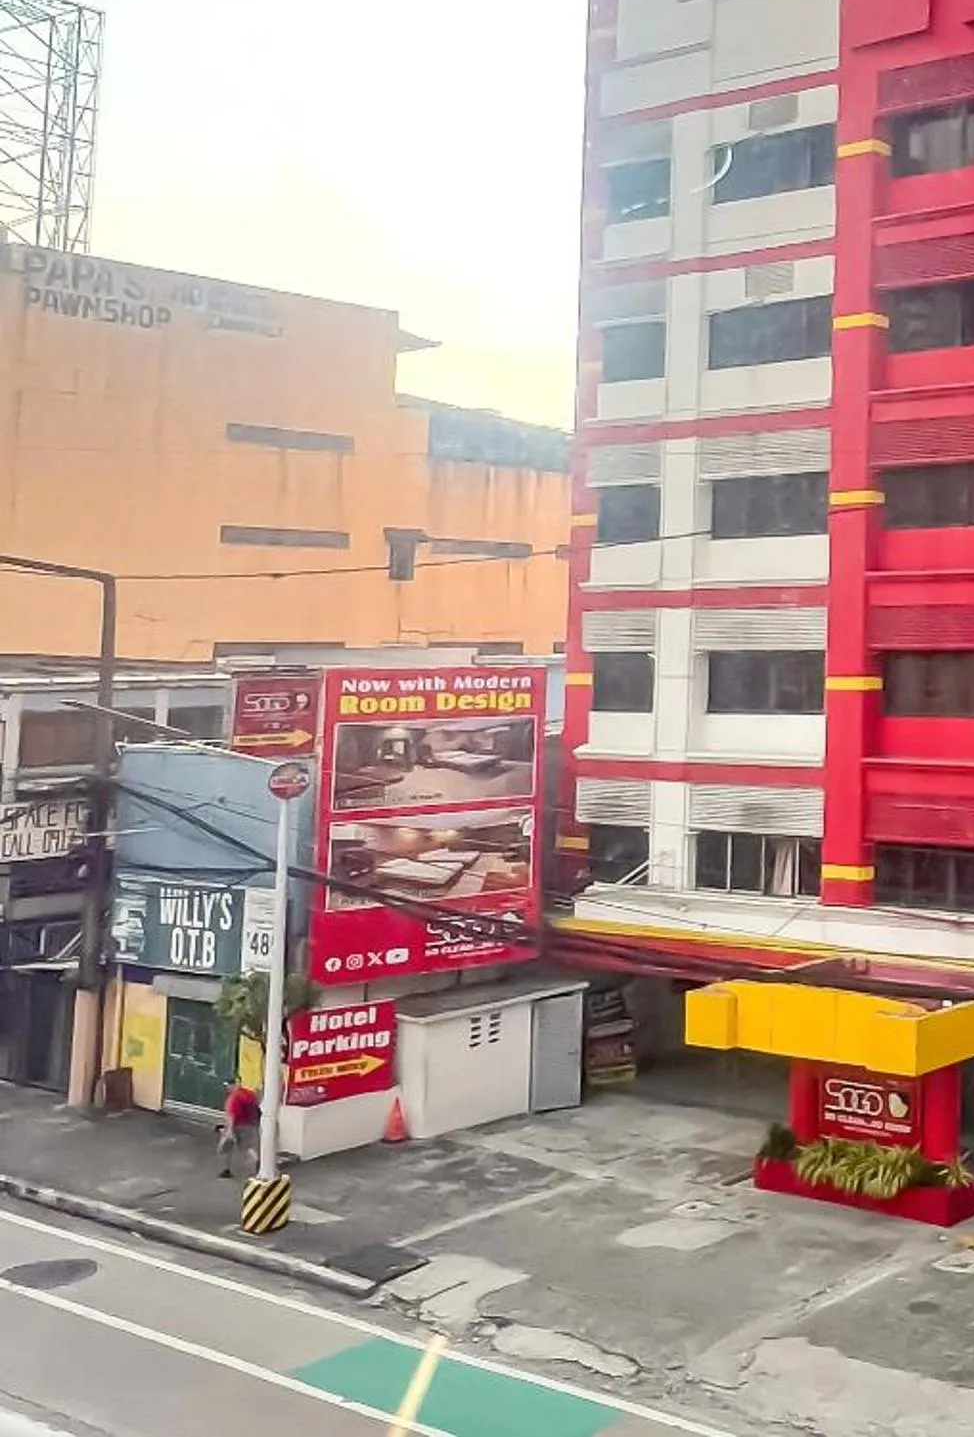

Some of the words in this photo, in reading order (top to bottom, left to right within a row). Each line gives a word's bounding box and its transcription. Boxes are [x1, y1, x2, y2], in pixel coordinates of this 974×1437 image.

[24, 286, 172, 329] PAWNSHOP
[341, 679, 391, 693] Now
[399, 676, 447, 691] with
[453, 675, 532, 689] Modern
[340, 695, 425, 714] Room
[436, 691, 532, 712] Design
[160, 888, 232, 930] WILLY'S
[309, 1007, 377, 1034] Hotel
[292, 1030, 390, 1059] Parking
